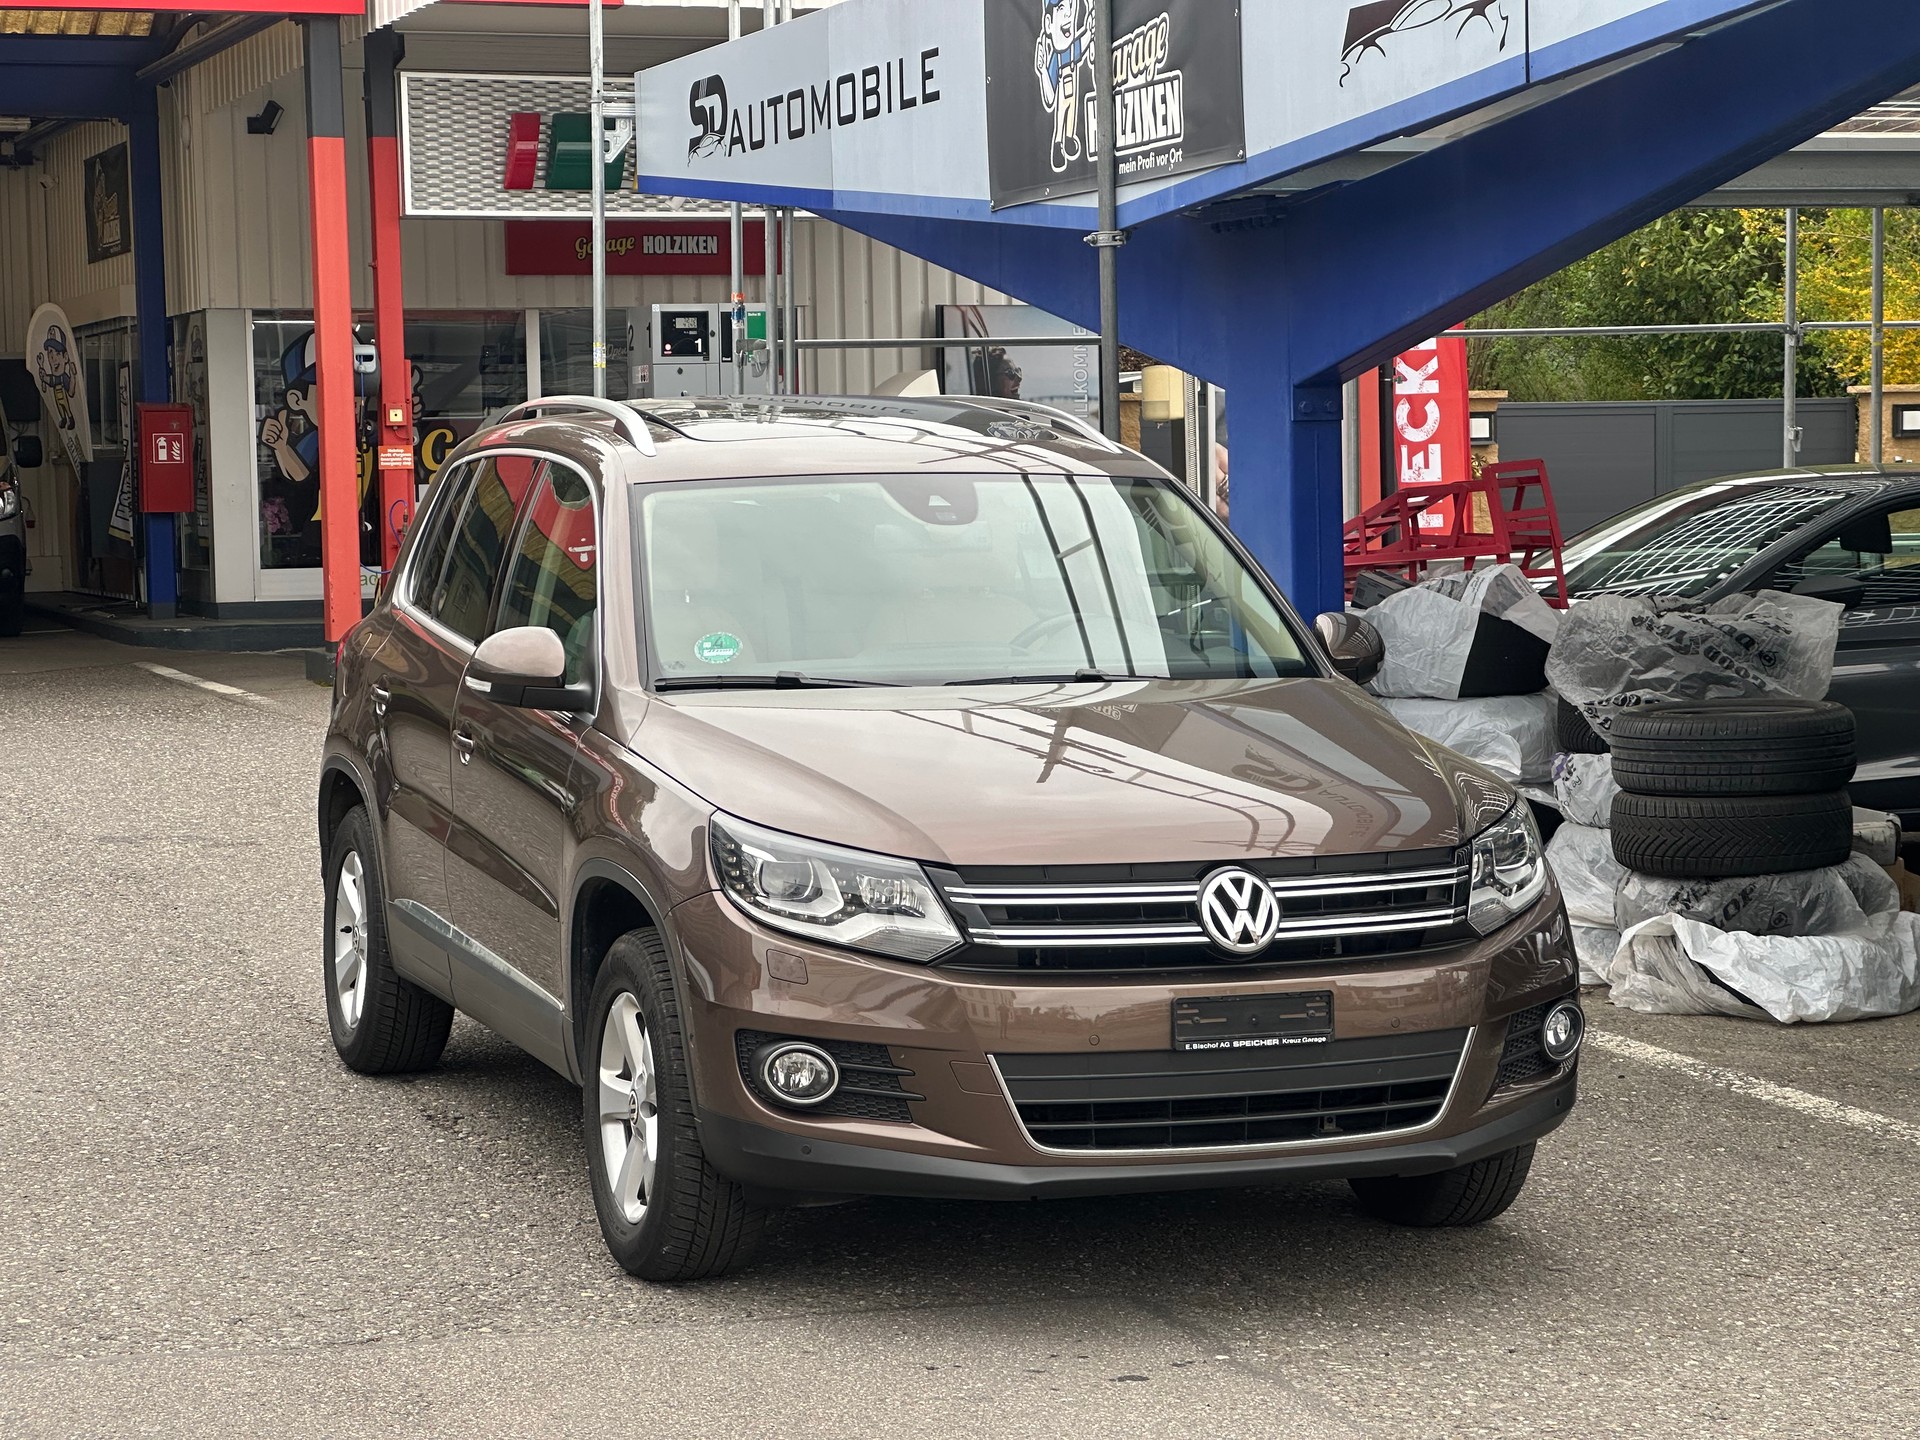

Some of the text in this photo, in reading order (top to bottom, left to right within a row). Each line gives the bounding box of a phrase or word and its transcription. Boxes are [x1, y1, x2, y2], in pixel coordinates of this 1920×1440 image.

[1112, 17, 1169, 87] arage
[728, 47, 940, 157] AUTOMOBILE
[1087, 79, 1181, 153] HLZIKEN
[1118, 148, 1183, 174] mein Profi vor Ort
[575, 235, 718, 260] Gage HOLZIKEN
[628, 325, 635, 351] 2
[694, 338, 702, 353] 1
[1199, 865, 1280, 954] VW
[1233, 1039, 1279, 1048] SPEICHER
[1282, 1037, 1301, 1045] Kreuz
[1302, 1036, 1327, 1044] Garage
